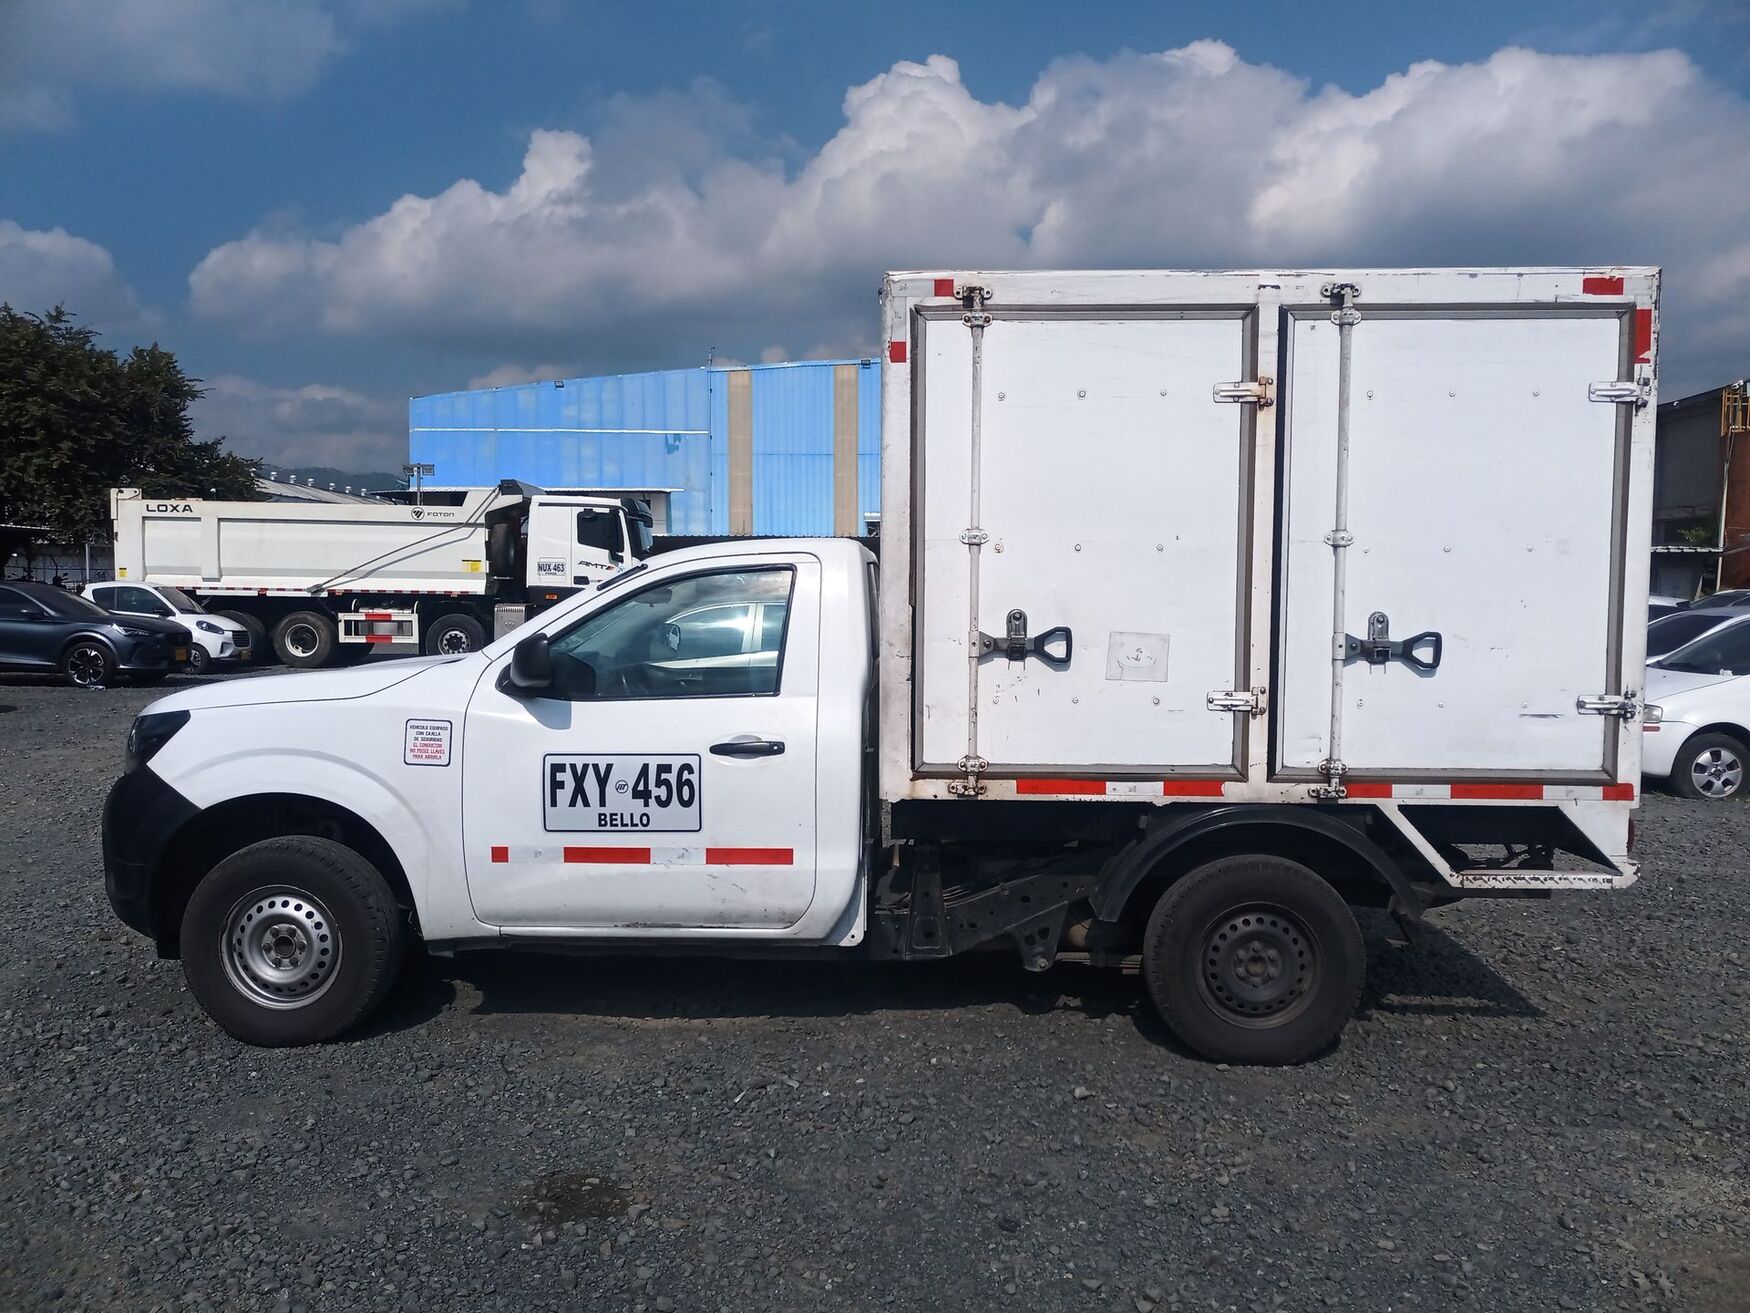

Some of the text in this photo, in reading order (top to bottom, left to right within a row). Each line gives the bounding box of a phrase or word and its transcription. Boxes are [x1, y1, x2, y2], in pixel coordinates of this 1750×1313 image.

[146, 504, 193, 513] LOXA
[537, 563, 565, 573] NUX 463
[549, 762, 696, 809] FXY 456
[597, 812, 651, 828] BELLO
